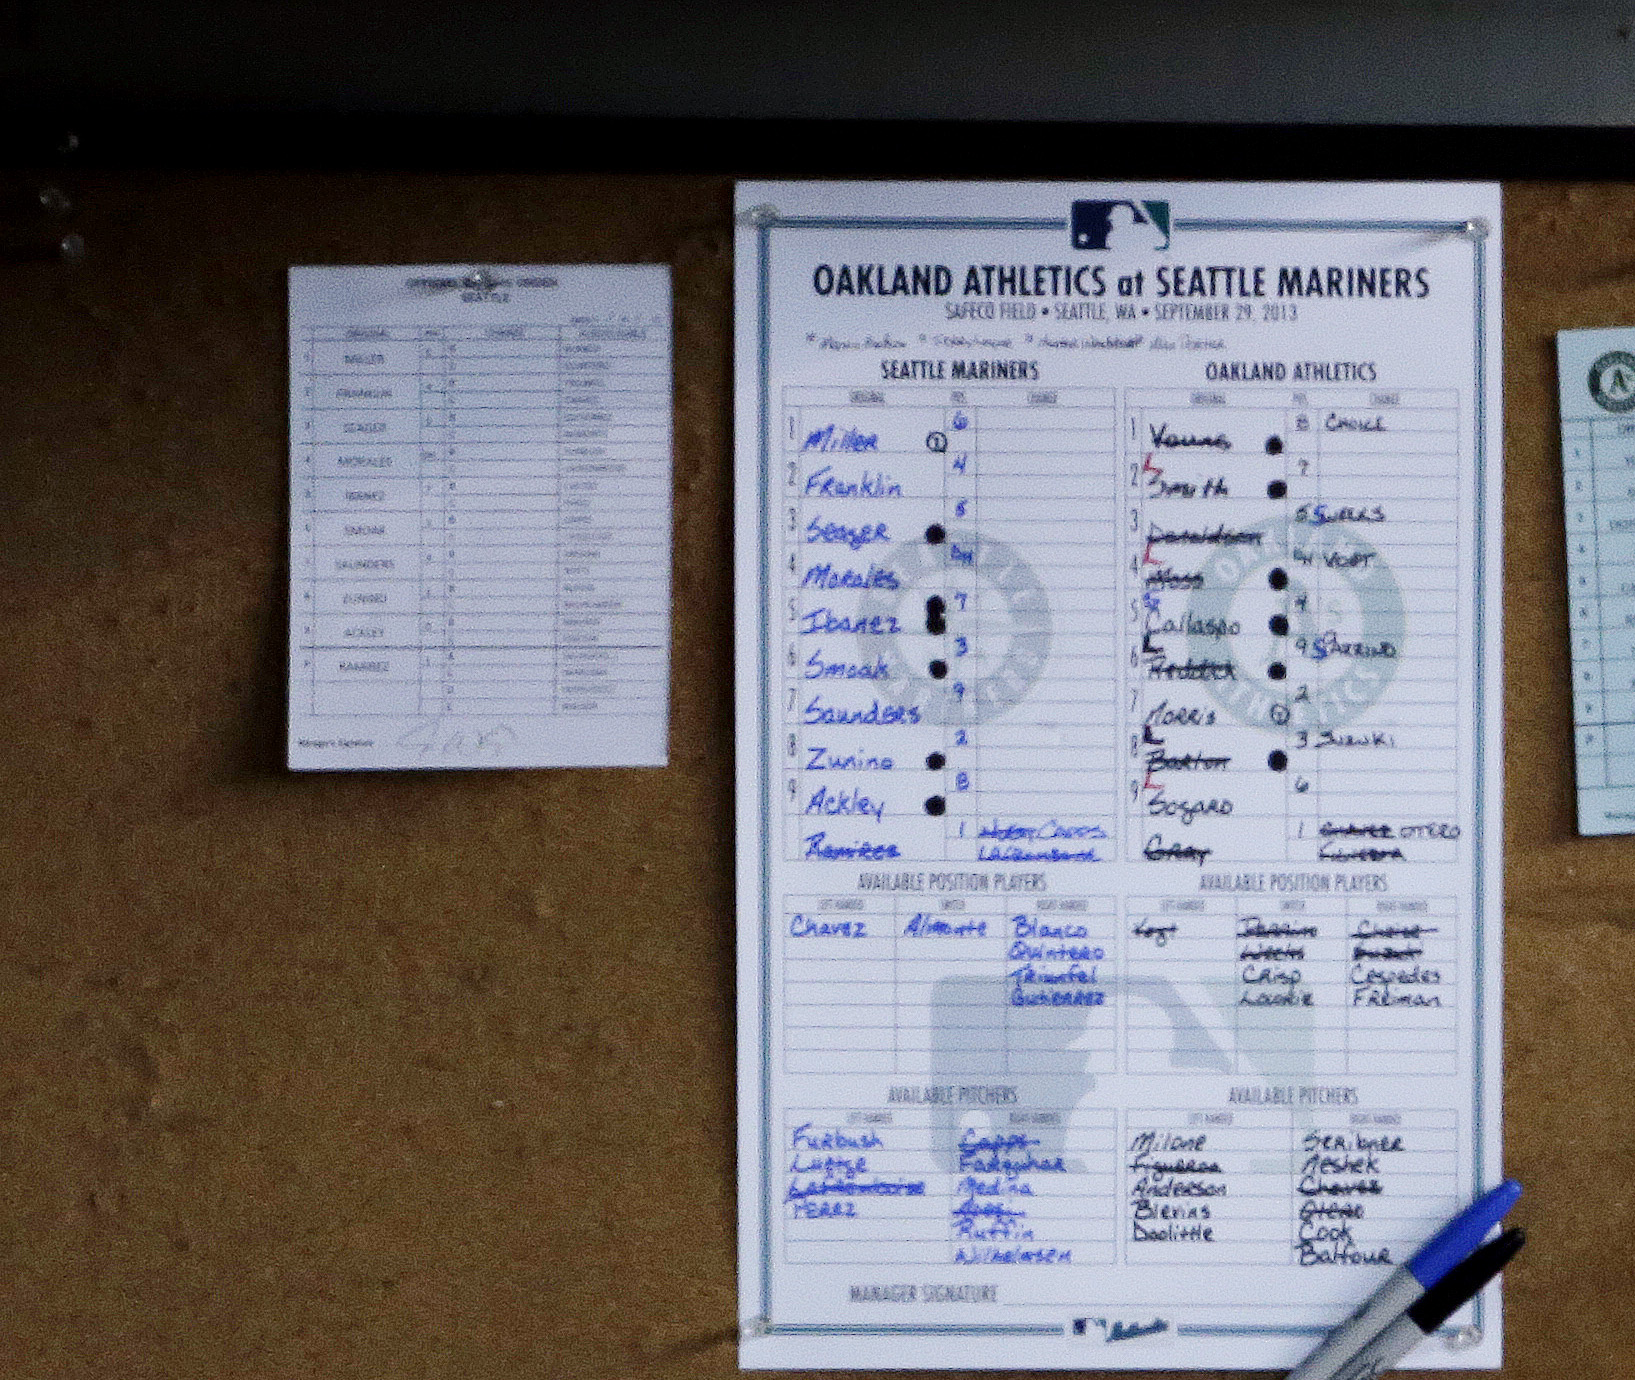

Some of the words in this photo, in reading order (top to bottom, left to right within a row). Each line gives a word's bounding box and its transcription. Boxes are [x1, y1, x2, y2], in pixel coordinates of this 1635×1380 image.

[812, 264, 954, 297] OAKLAND
[963, 264, 1107, 297] ATHLETICS
[1116, 269, 1144, 297] at
[1156, 265, 1266, 298] SEATTLE
[1277, 266, 1431, 299] MARINERS
[999, 302, 1037, 321] FIELD
[1115, 302, 1136, 321] WA
[1154, 303, 1229, 322] SEPTEMBER
[1262, 303, 1298, 322] 2013
[880, 359, 945, 380] SEATTLE
[951, 359, 1040, 380] MARINERS
[1205, 361, 1287, 382] OAKLAND
[1292, 361, 1378, 382] ATHLETICS
[953, 453, 968, 475] 4
[954, 592, 968, 612] 7
[805, 748, 894, 770] Zunino
[856, 872, 924, 892] AVAILABLE
[929, 872, 988, 892] POSITION
[993, 872, 1047, 892] PLAYERS
[1199, 872, 1266, 892] AVAILABLE
[1269, 872, 1328, 892] POSITION
[1334, 872, 1388, 892] PLAYERS
[887, 1085, 955, 1104] AVAILABLE
[957, 1085, 1019, 1104] PITCHERS
[1228, 1086, 1294, 1105] AVAILABLE
[1298, 1086, 1358, 1105] PITCHERS
[849, 1284, 918, 1303] MANAGER
[920, 1284, 997, 1303] SIGNATURE
